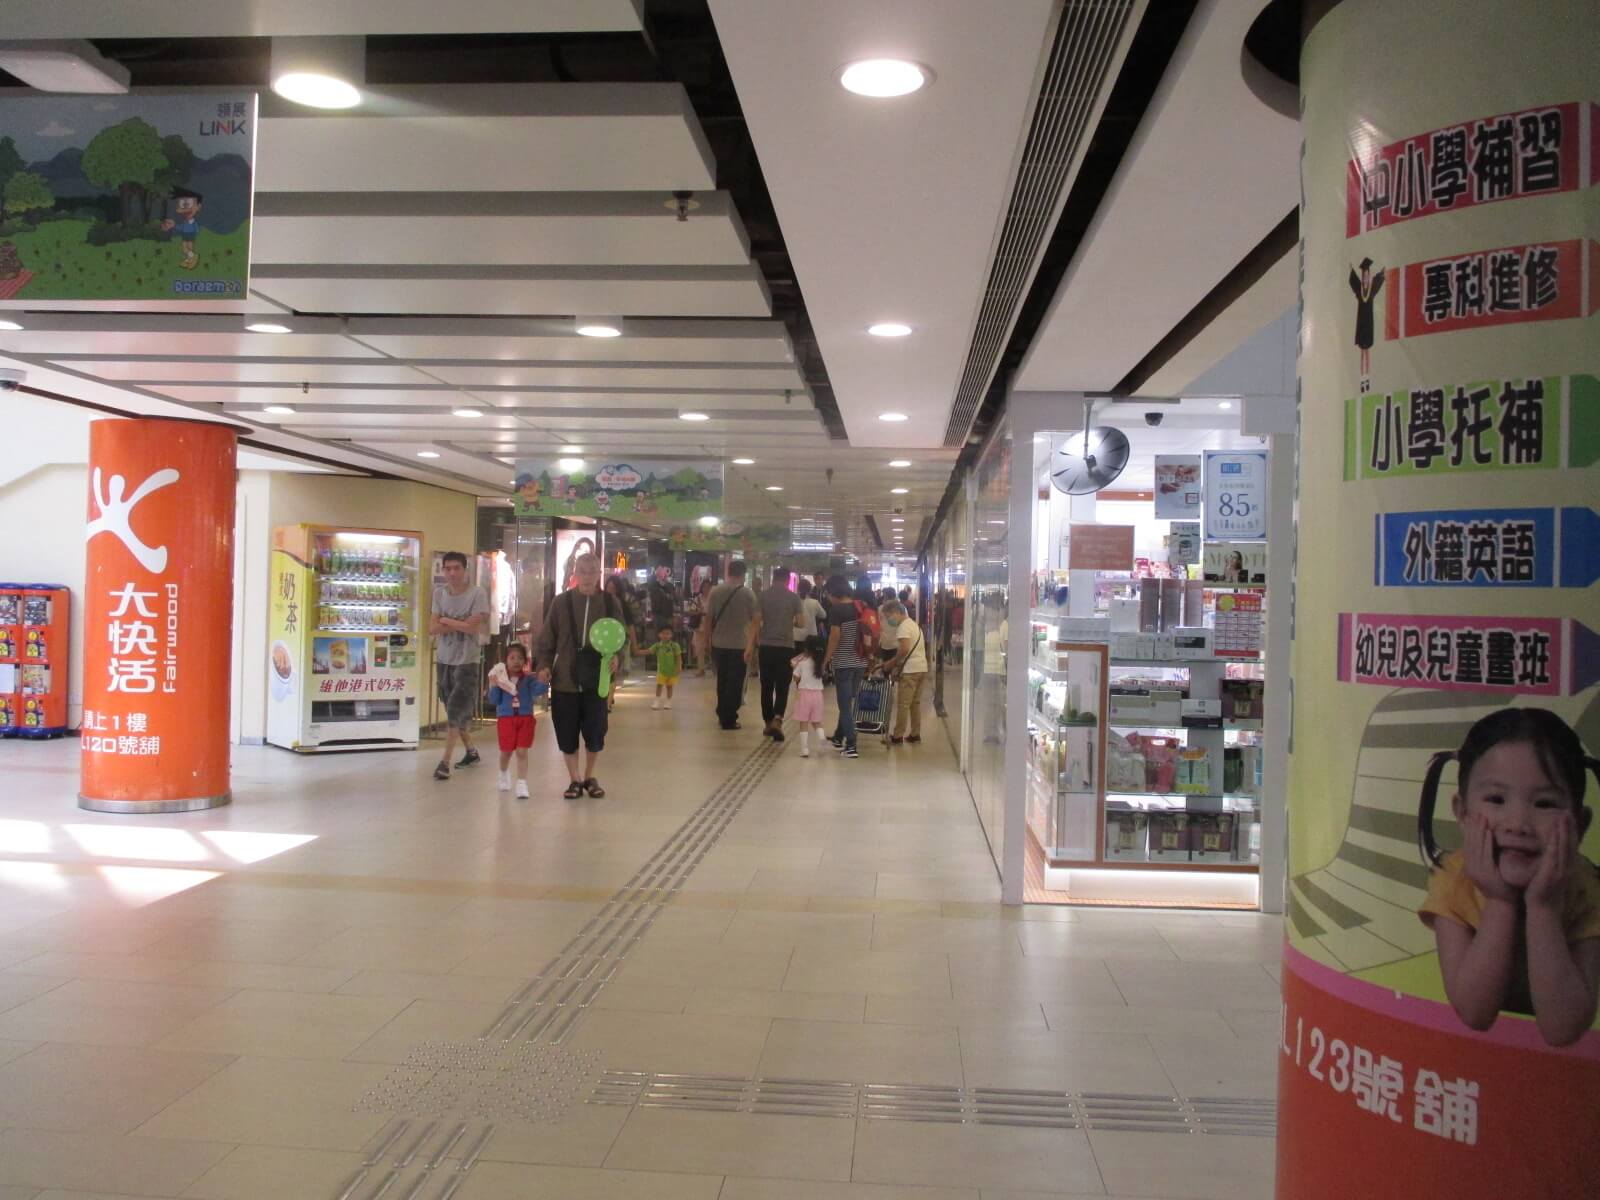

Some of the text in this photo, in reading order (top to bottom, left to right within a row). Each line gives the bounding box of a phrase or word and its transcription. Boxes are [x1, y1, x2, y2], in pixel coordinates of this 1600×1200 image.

[200, 119, 246, 136] LINK
[1361, 111, 1561, 226] 中小學補習
[1424, 248, 1560, 322] 專科進修
[1371, 380, 1544, 471] 小學托補
[1403, 521, 1536, 582] 外籍英語
[107, 583, 158, 693] 大快活
[163, 583, 178, 692] Fairwood
[1354, 626, 1551, 687] 幼兒及兒童畫班
[319, 678, 406, 693] 維他港式奶茶
